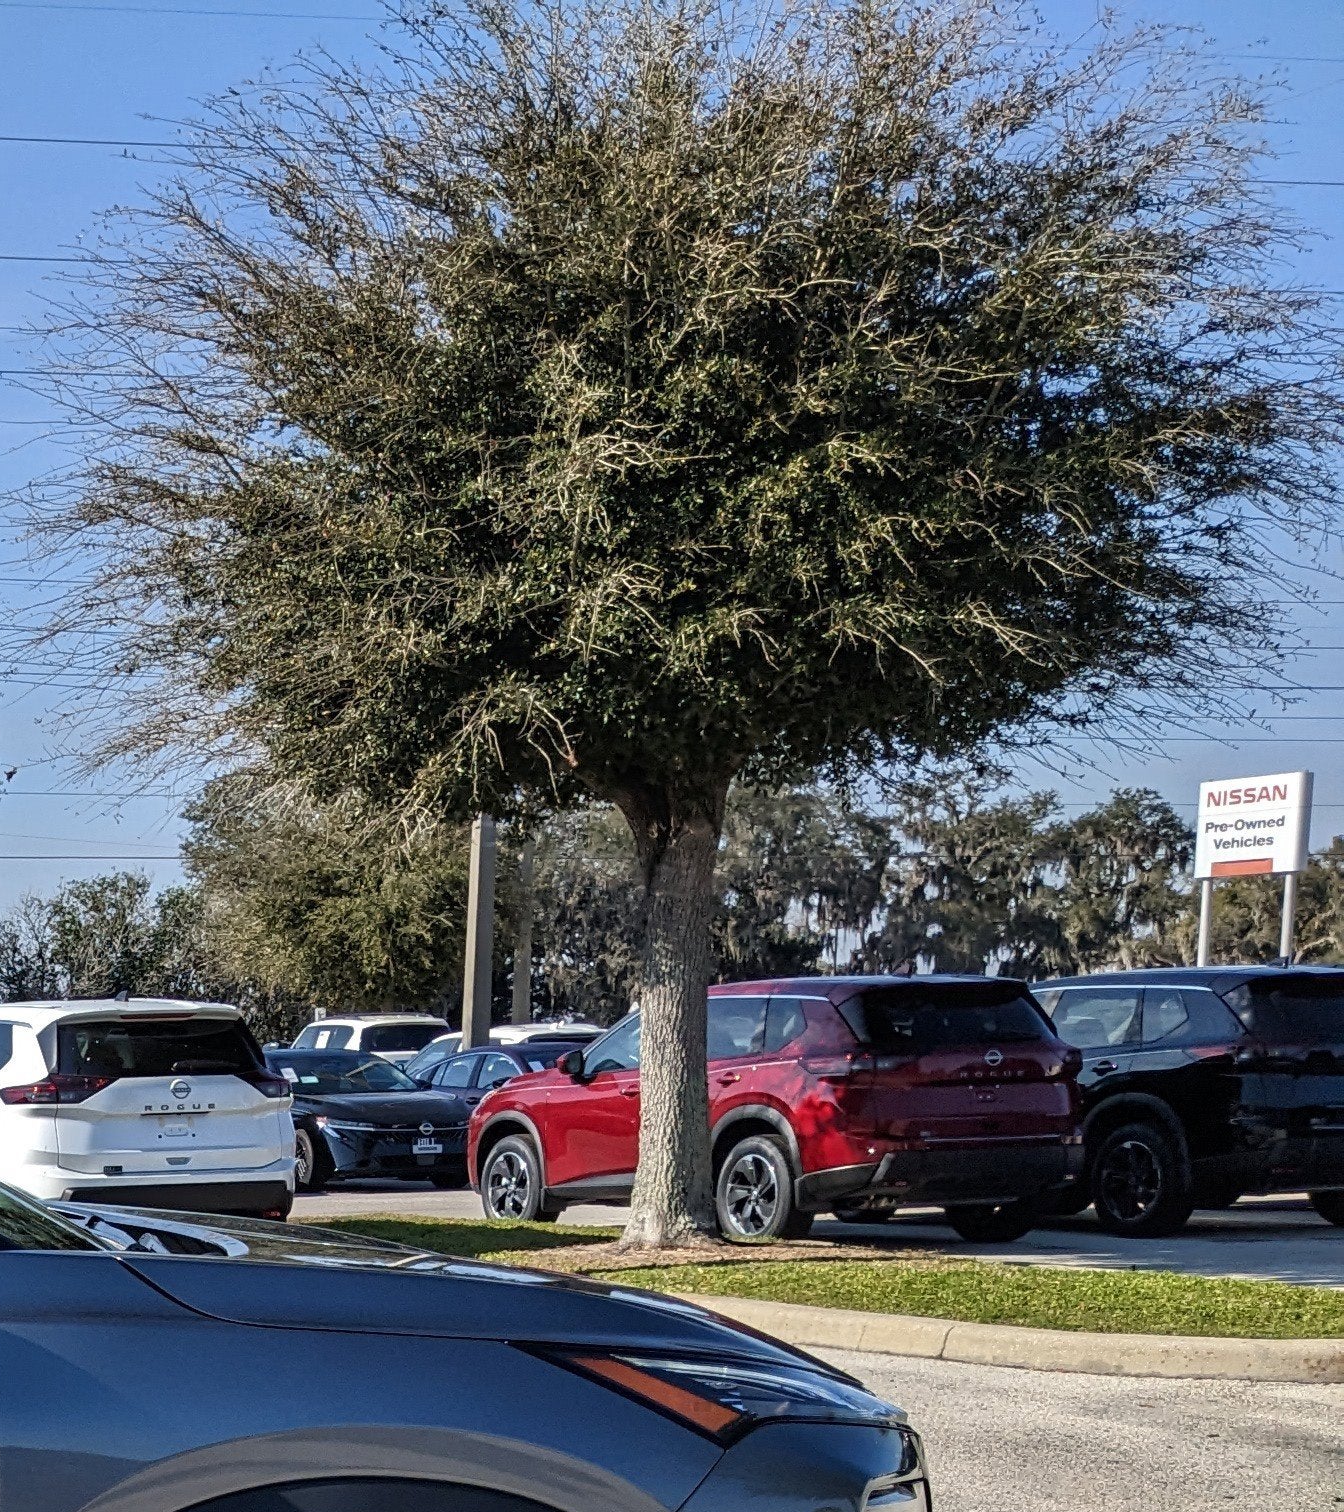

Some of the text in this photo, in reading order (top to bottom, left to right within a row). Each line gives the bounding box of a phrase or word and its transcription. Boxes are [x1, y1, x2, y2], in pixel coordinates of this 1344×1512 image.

[1206, 784, 1288, 808] NISSAN
[1204, 815, 1286, 833] Pre-Owned
[1213, 835, 1274, 850] Vehicles
[144, 1103, 216, 1112] ROGUE
